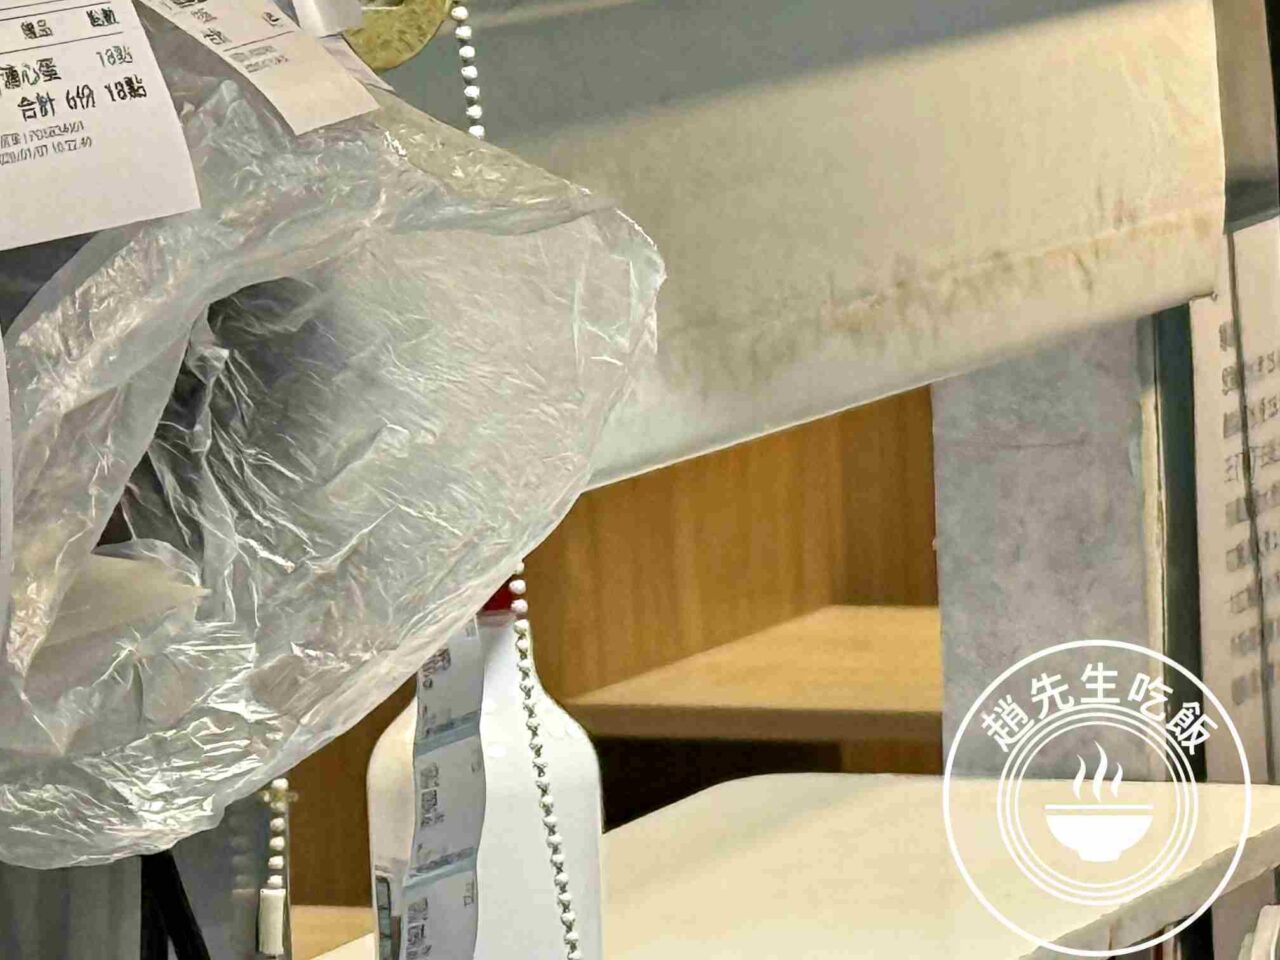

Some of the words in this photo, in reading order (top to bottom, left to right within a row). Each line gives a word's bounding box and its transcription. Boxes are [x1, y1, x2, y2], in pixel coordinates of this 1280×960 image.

[17, 91, 56, 122] 合計
[65, 84, 96, 110] 6份
[104, 74, 147, 102] 18點
